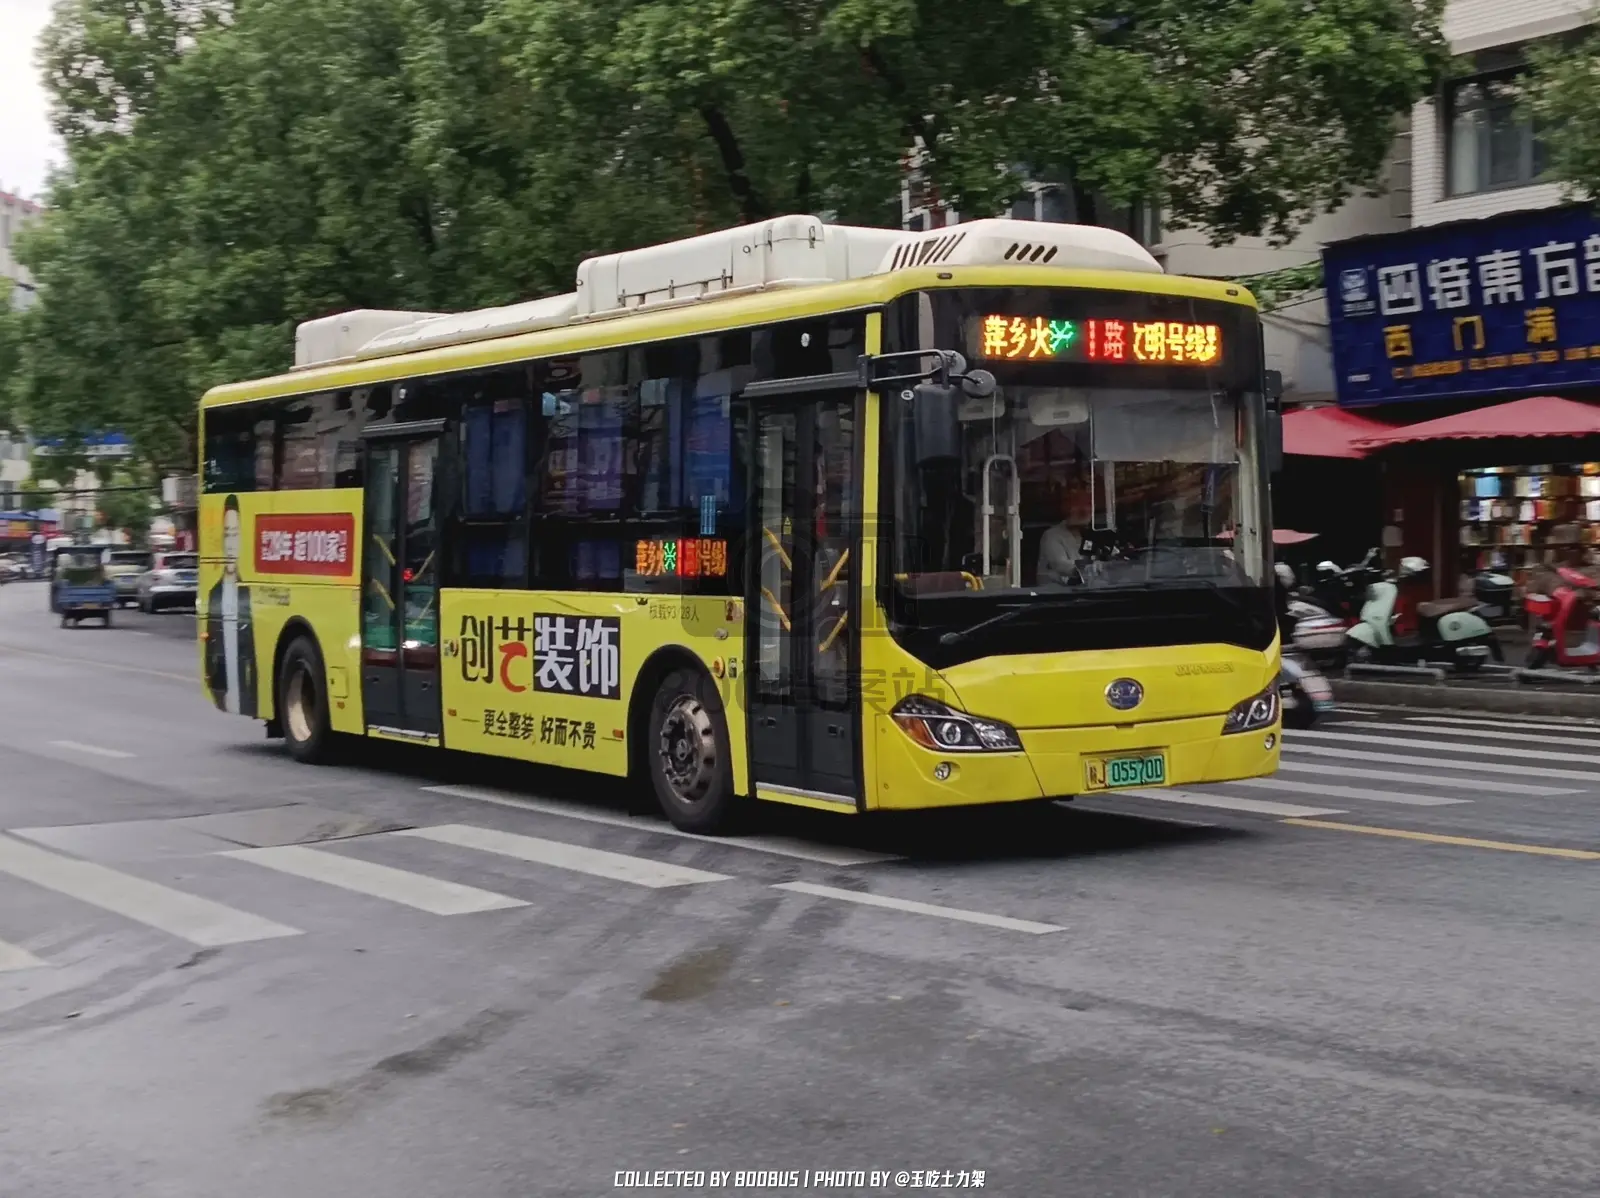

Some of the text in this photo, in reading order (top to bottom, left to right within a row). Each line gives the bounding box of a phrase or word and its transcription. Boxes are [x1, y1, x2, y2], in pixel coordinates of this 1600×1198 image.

[483, 708, 597, 750] 更全整装 好而不贵
